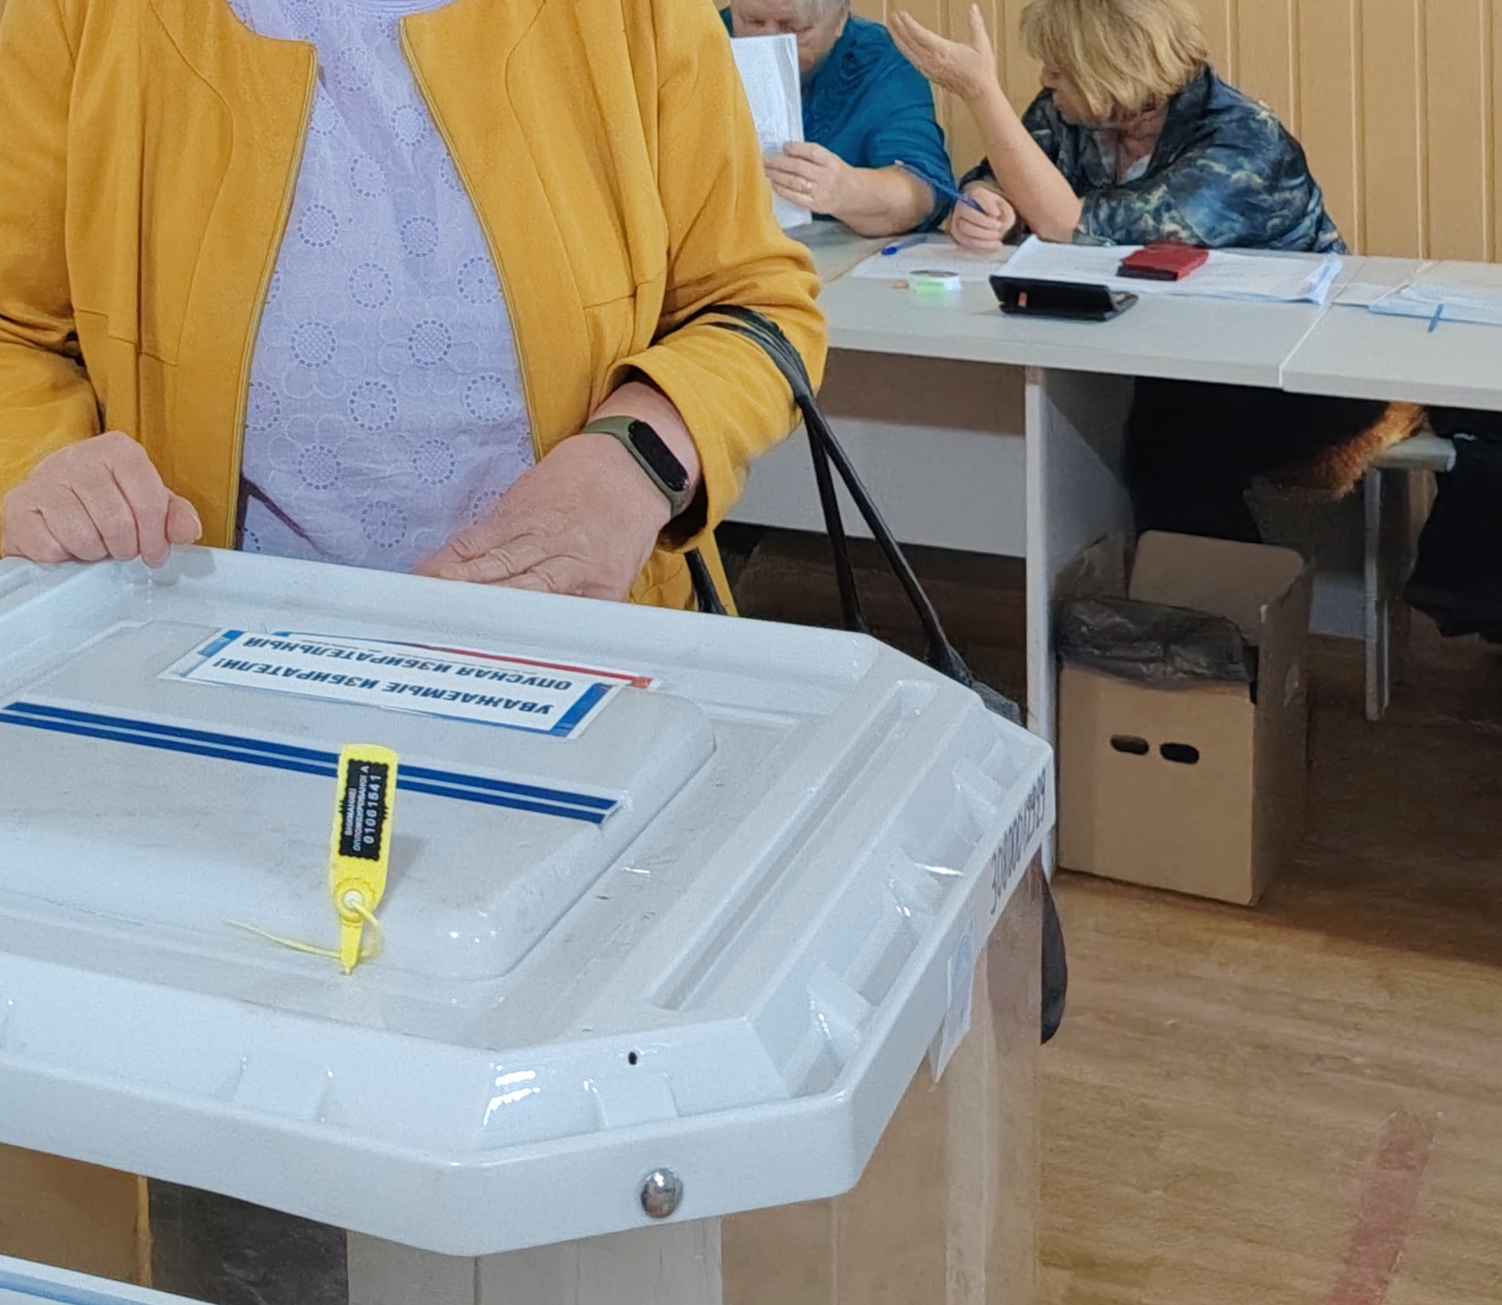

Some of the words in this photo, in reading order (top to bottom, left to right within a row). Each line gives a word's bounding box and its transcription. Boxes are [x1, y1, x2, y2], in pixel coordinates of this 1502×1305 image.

[211, 655, 381, 691] ИЗБИРАТЕЛИ!
[242, 636, 453, 674] ИЗБИРАТЕЛЬНЫЙ
[456, 666, 573, 692] ОПУСКАЯ
[380, 679, 555, 716] УВАЖАЕМЫЕ
